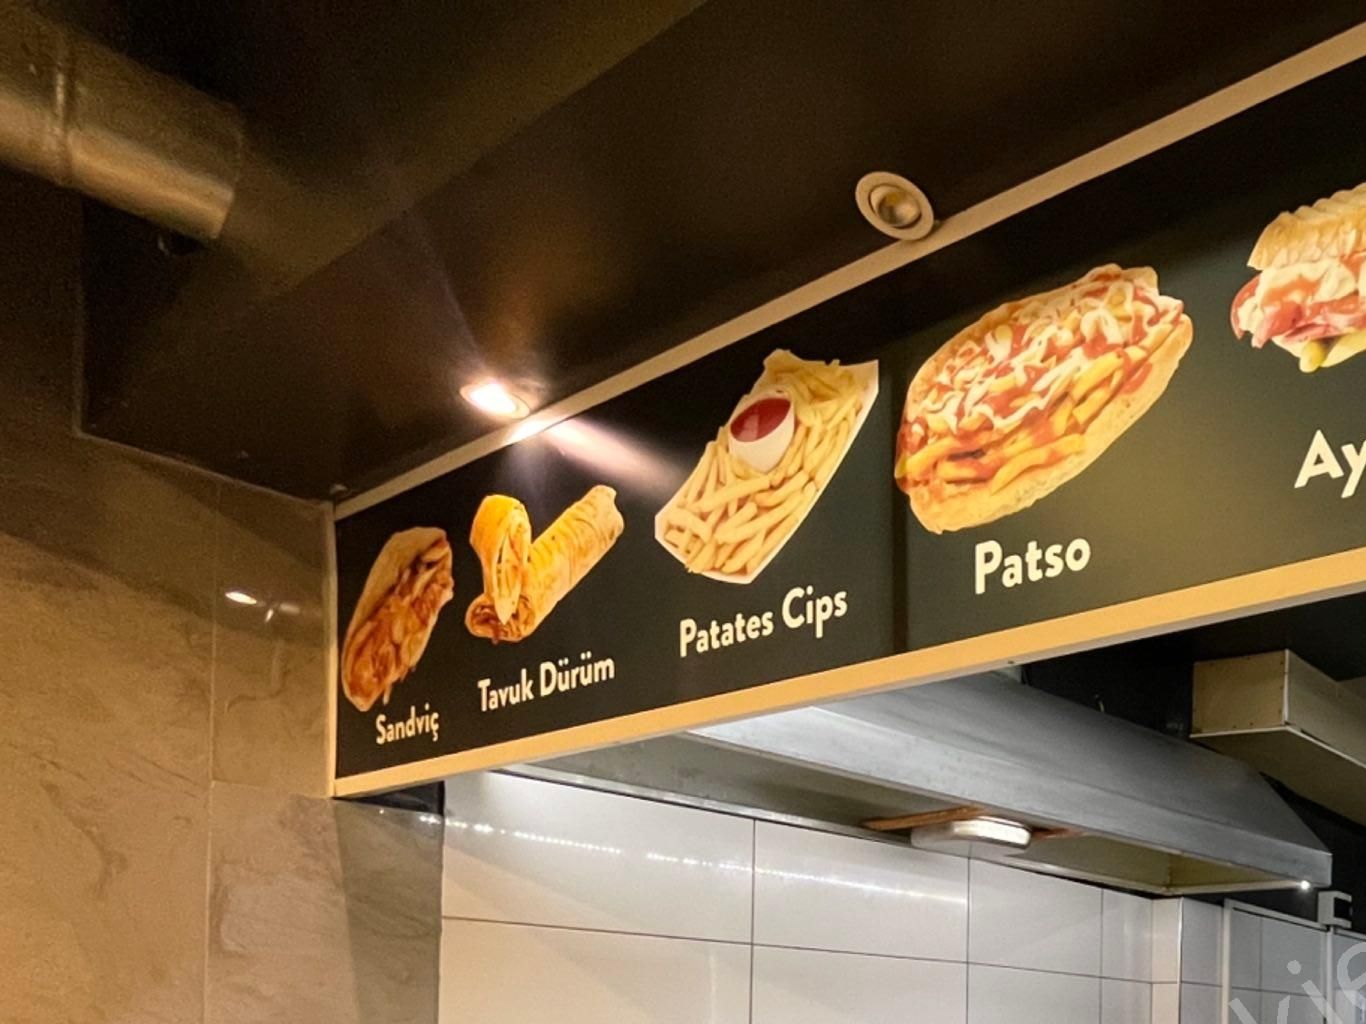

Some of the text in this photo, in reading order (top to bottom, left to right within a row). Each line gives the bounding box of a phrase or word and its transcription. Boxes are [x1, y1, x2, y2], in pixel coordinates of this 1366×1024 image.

[974, 538, 1092, 595] Patso
[679, 585, 848, 657] Patates Cips
[477, 651, 615, 712] Tavuk Dürüm
[375, 702, 440, 745] Sandviç
